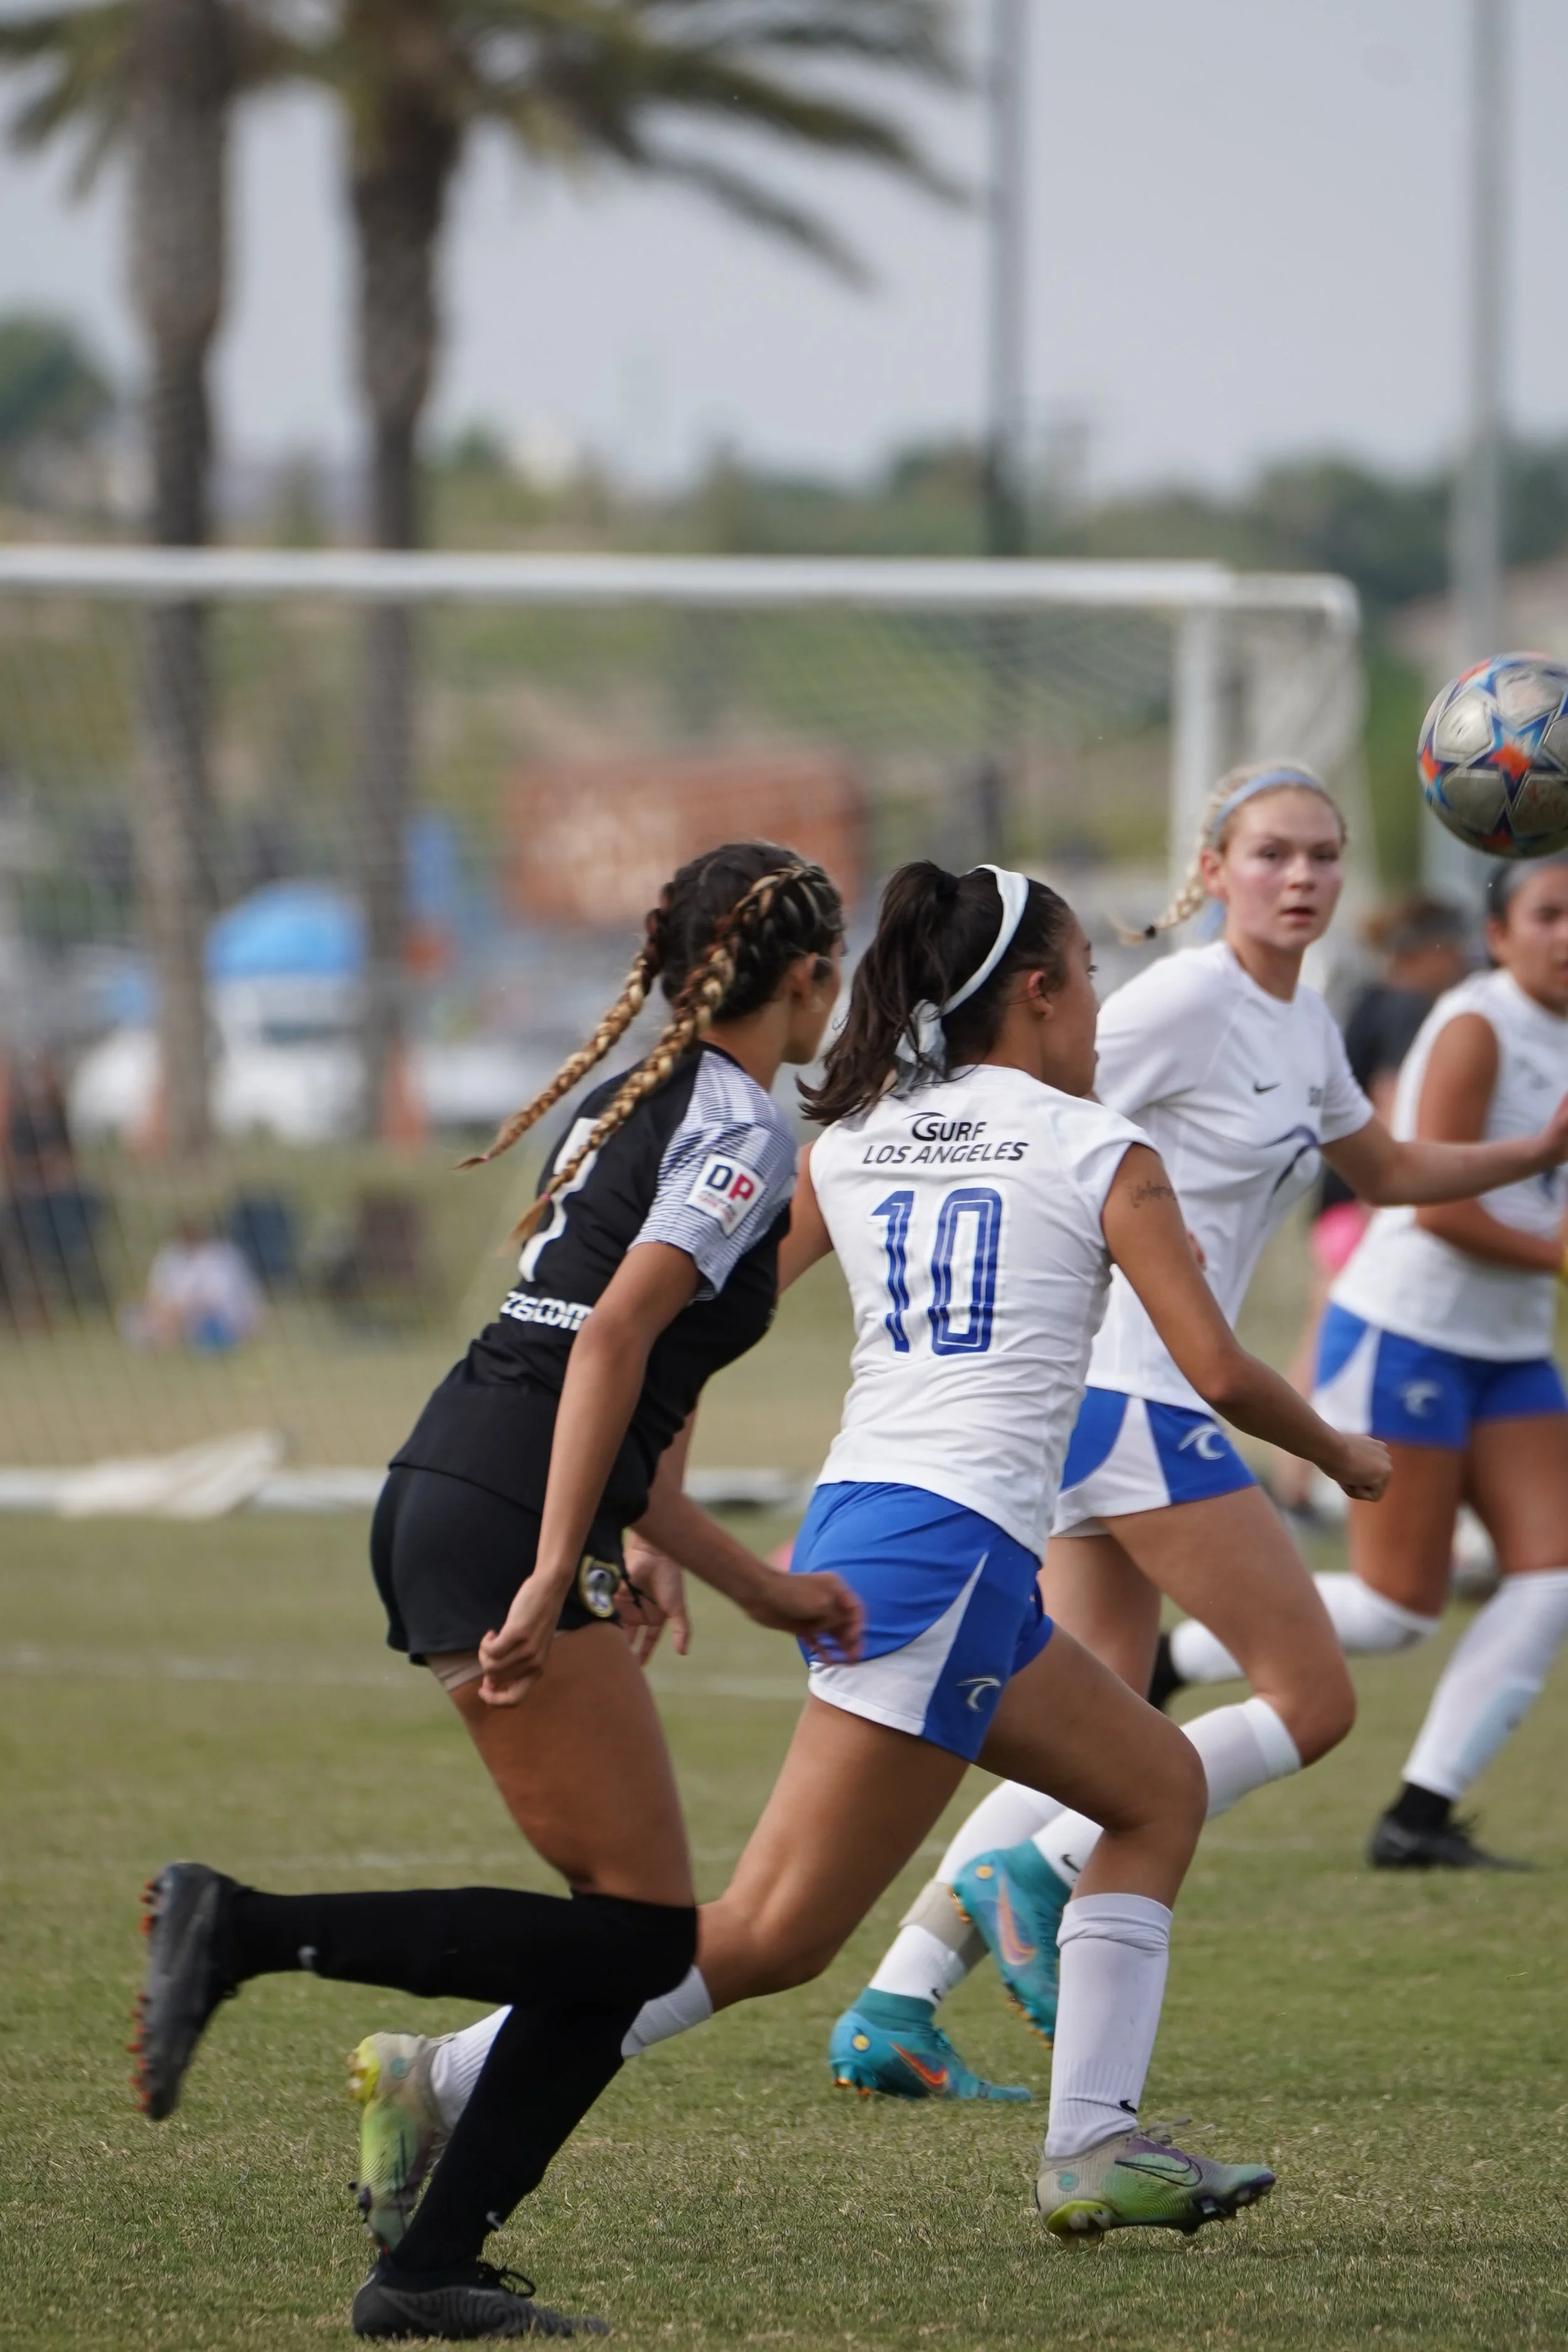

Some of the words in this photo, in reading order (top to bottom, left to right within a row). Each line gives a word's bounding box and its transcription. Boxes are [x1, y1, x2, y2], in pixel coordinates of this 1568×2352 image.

[911, 1116, 988, 1142] SURF
[862, 1145, 913, 1164] LOS
[910, 1141, 1030, 1163] ANGELES
[870, 1187, 1003, 1356] 10
